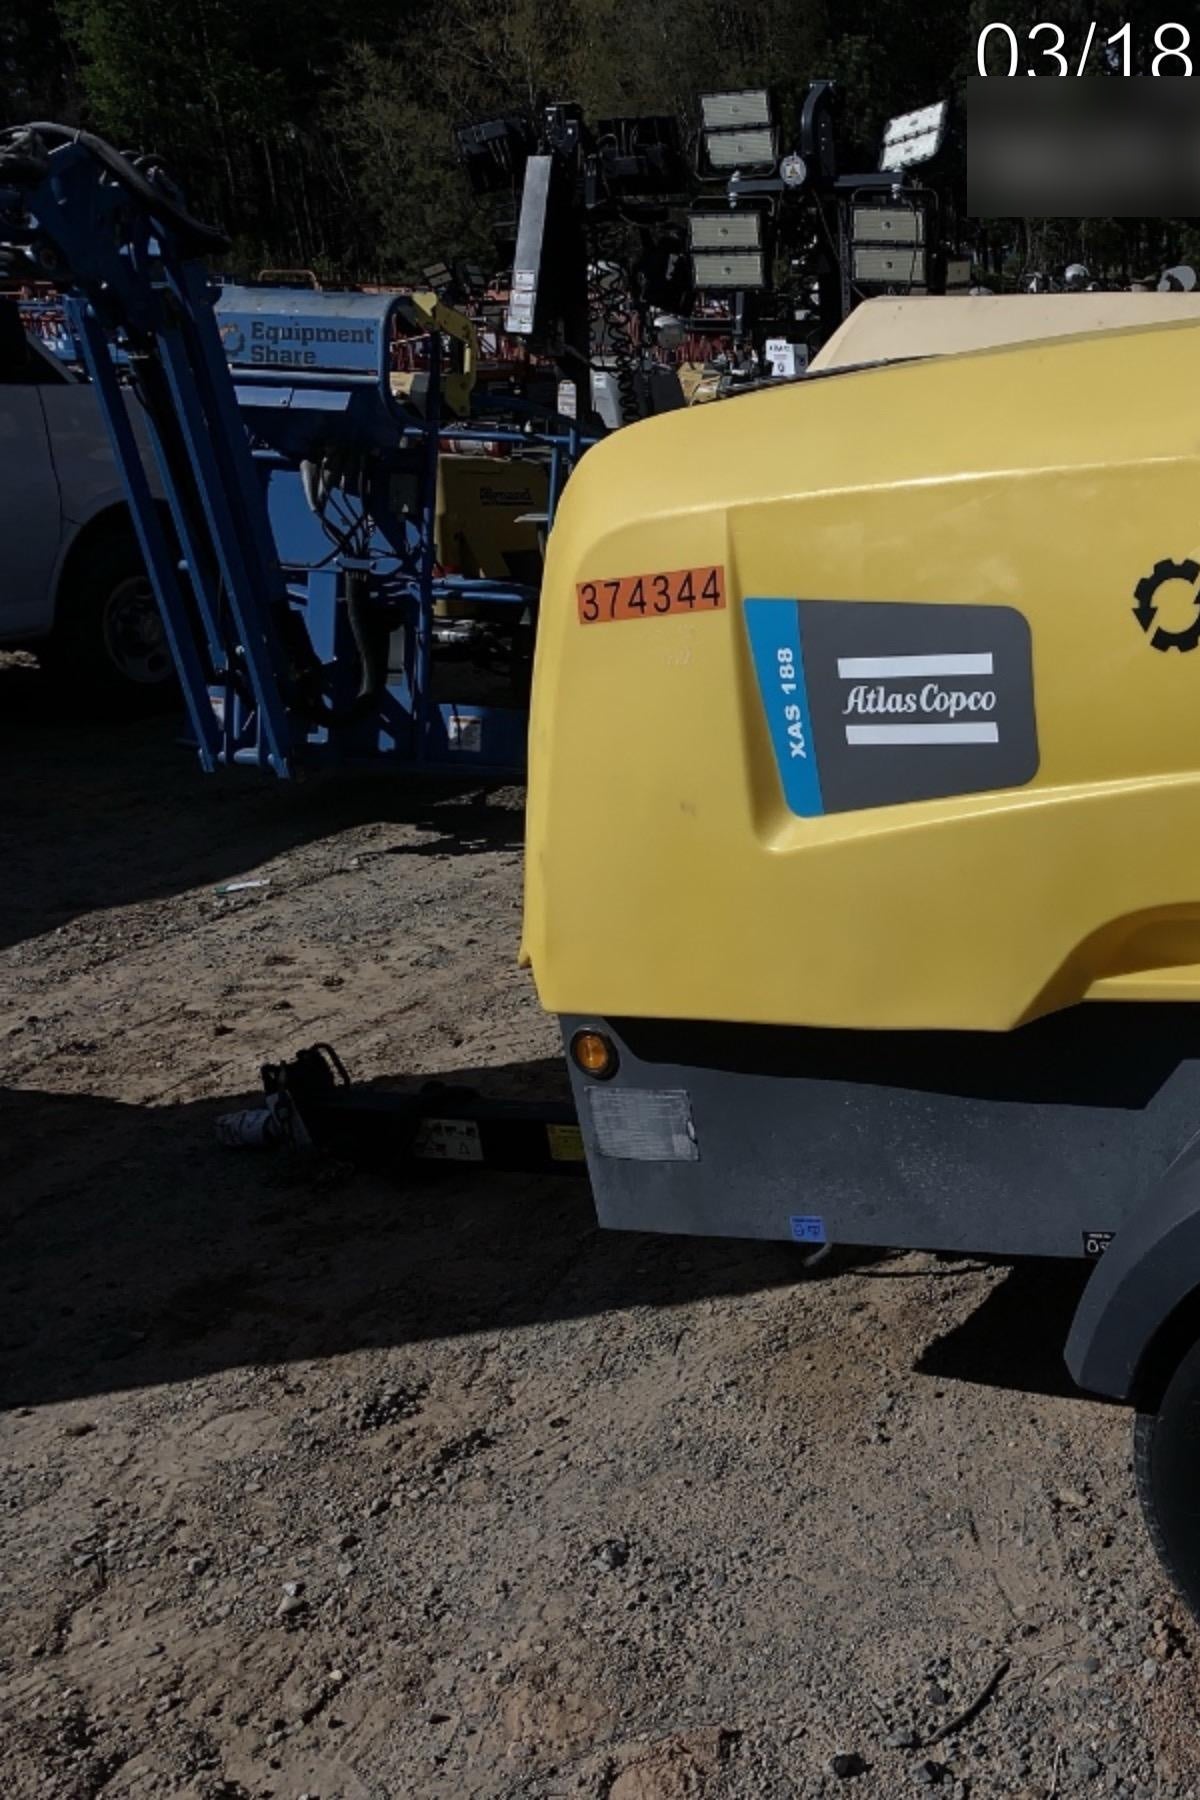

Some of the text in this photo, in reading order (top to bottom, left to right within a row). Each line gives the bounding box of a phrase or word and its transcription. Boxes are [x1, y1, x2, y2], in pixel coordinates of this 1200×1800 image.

[251, 321, 375, 345] Equipment
[251, 346, 317, 365] Share
[579, 568, 721, 622] 374344
[777, 647, 807, 758] XAS 188
[842, 683, 996, 718] Atlas Copco
